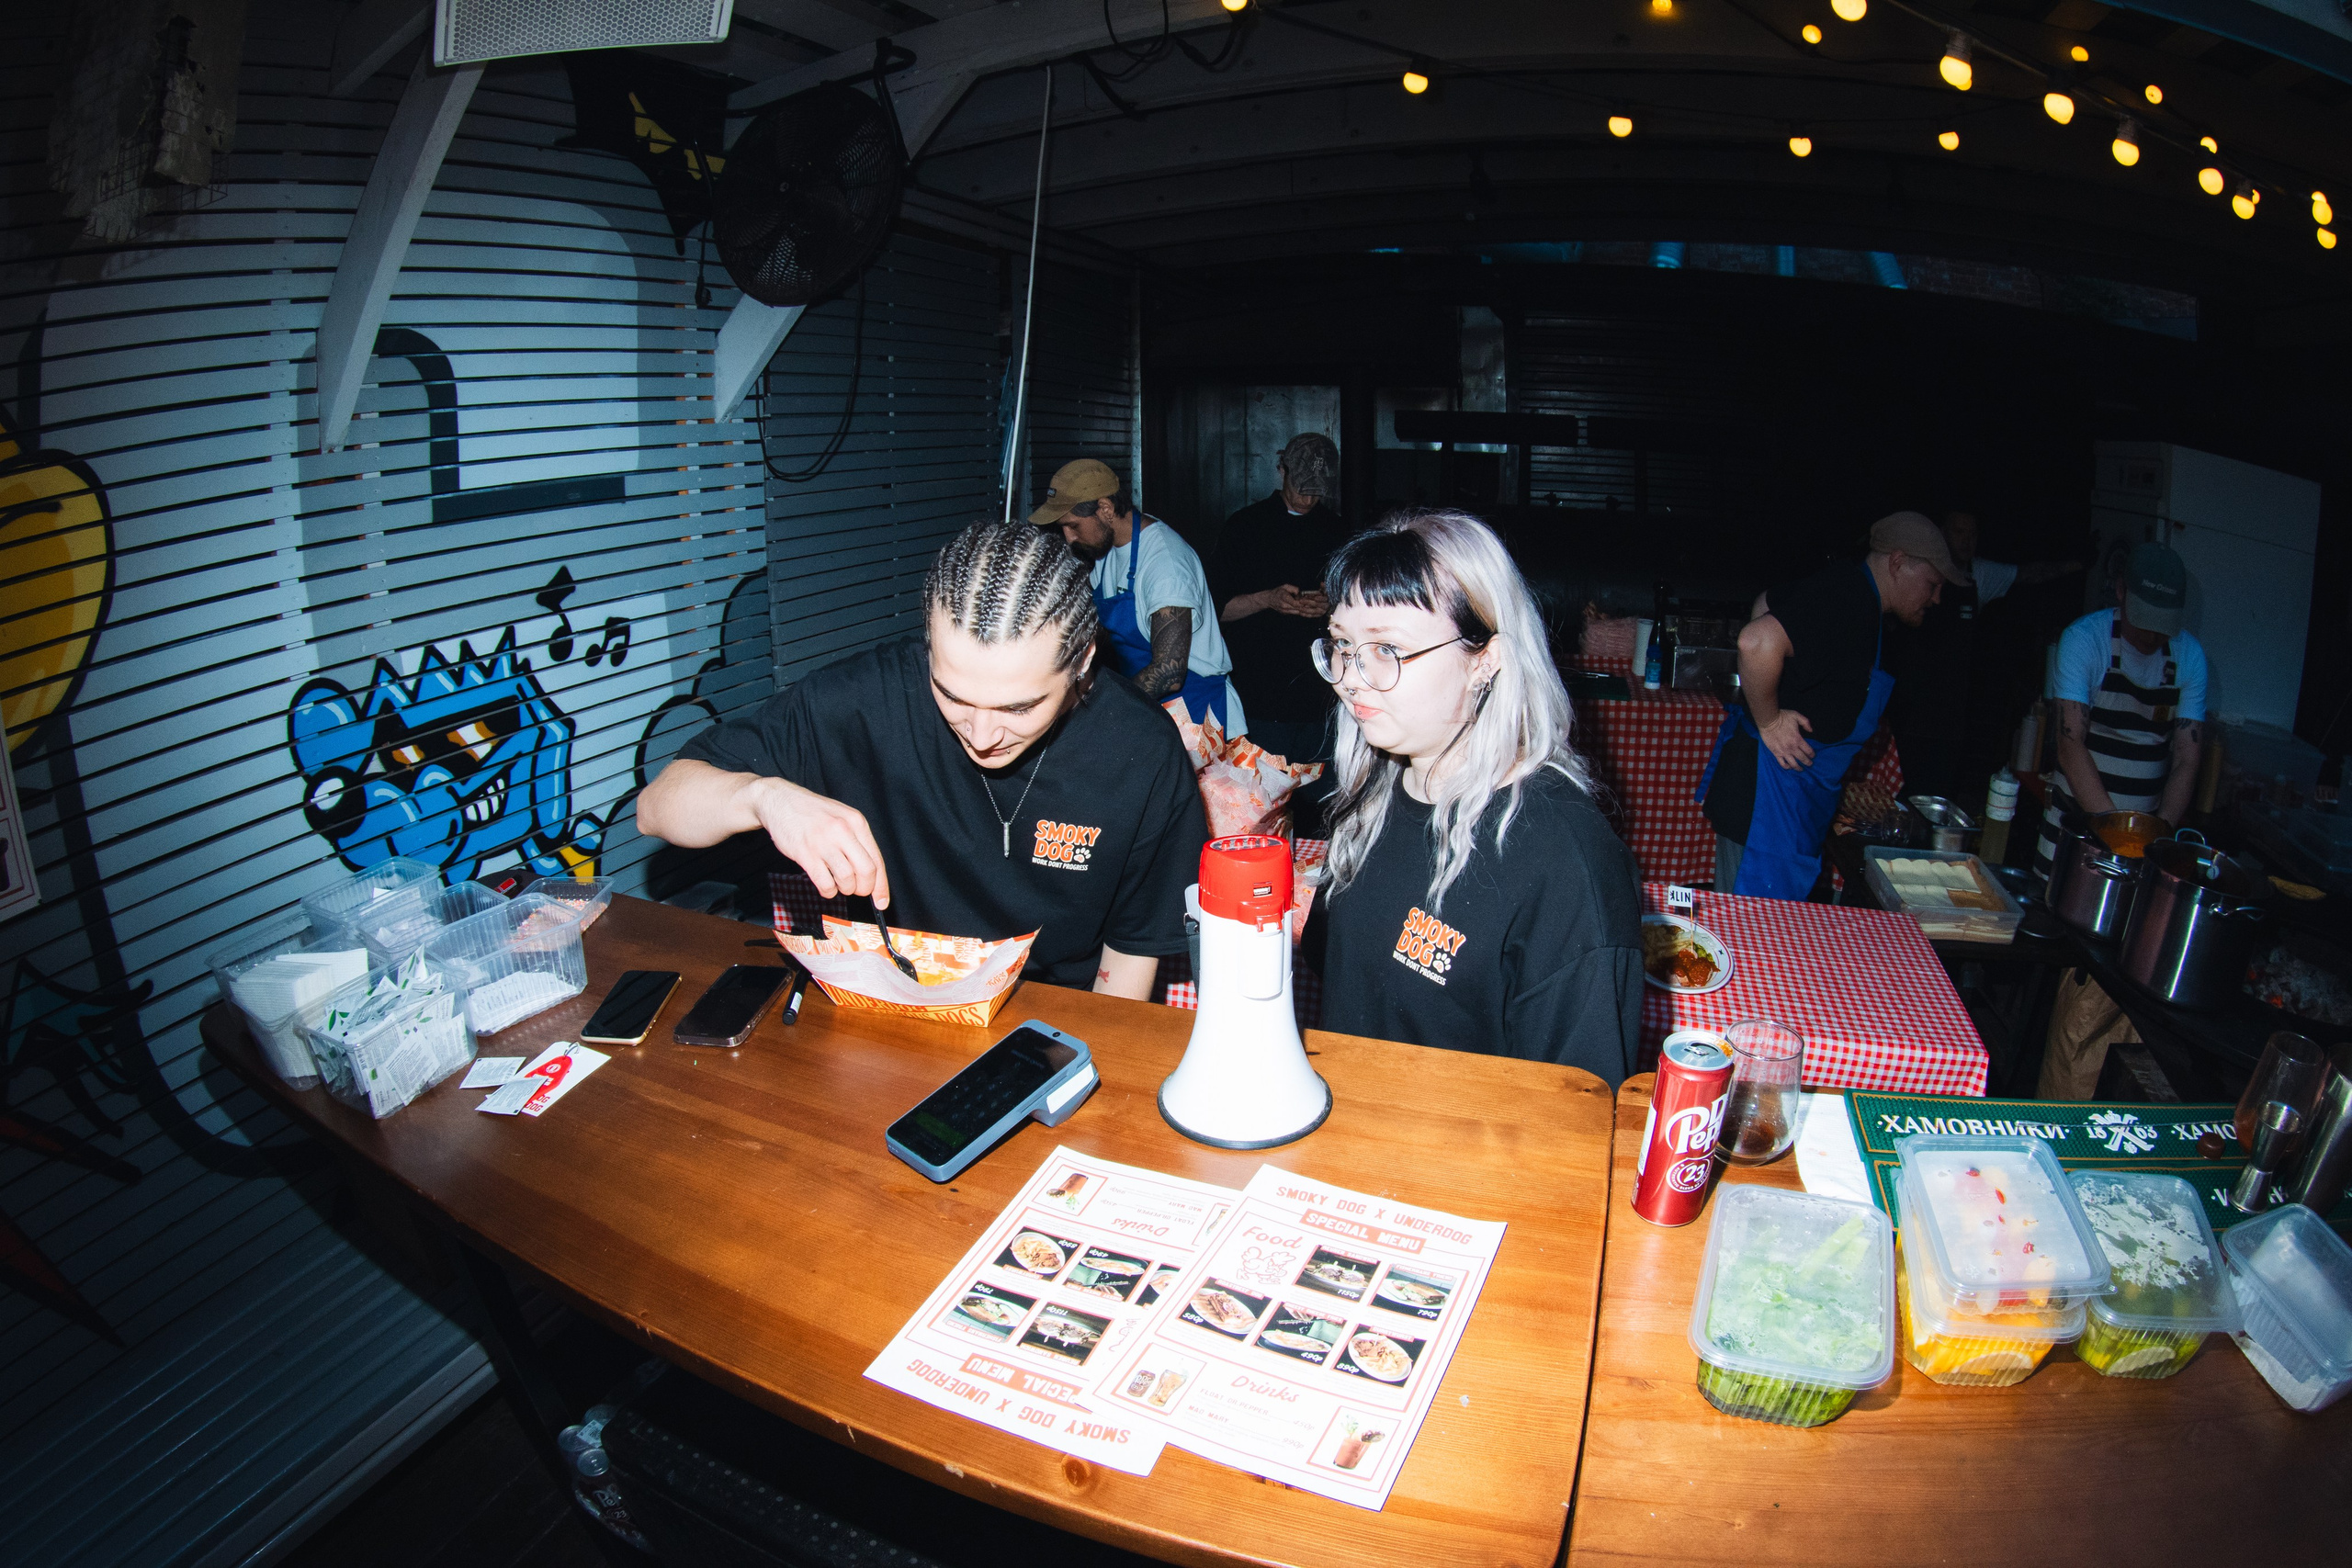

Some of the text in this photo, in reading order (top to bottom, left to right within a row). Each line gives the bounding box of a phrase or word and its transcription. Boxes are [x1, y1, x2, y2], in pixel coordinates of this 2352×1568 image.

[1035, 819, 1102, 846] SMOKY
[1032, 856, 1048, 866] WORK
[1062, 863, 1089, 871] PROGRESS
[1034, 840, 1075, 863] DOG
[1404, 907, 1466, 956] SMOKY
[1396, 929, 1436, 967] DOG
[1393, 950, 1408, 964] WORK
[1419, 966, 1447, 986] PROGRESS
[933, 1006, 985, 1027] DOGS
[1665, 1106, 1721, 1155] Pep
[1880, 1114, 2066, 1139] ХАМОВНИКИ
[2173, 1123, 2238, 1140] ХАМО
[1683, 1163, 1706, 1184] 23
[1111, 1217, 1170, 1237] Drinks
[1275, 1186, 1474, 1246] SMOKY DOG X UNDERDOG
[1241, 1225, 1303, 1250] Food
[1306, 1212, 1422, 1251] SPECIAL MENU
[967, 1357, 1076, 1404] PECIAL MENU
[1230, 1375, 1301, 1404] Drinks
[906, 1358, 1131, 1444] SMOKY DOG X UNDERDOG
[1200, 1388, 1226, 1402] FLOAT
[1188, 1404, 1205, 1415] MAD
[1206, 1411, 1230, 1424] MARY
